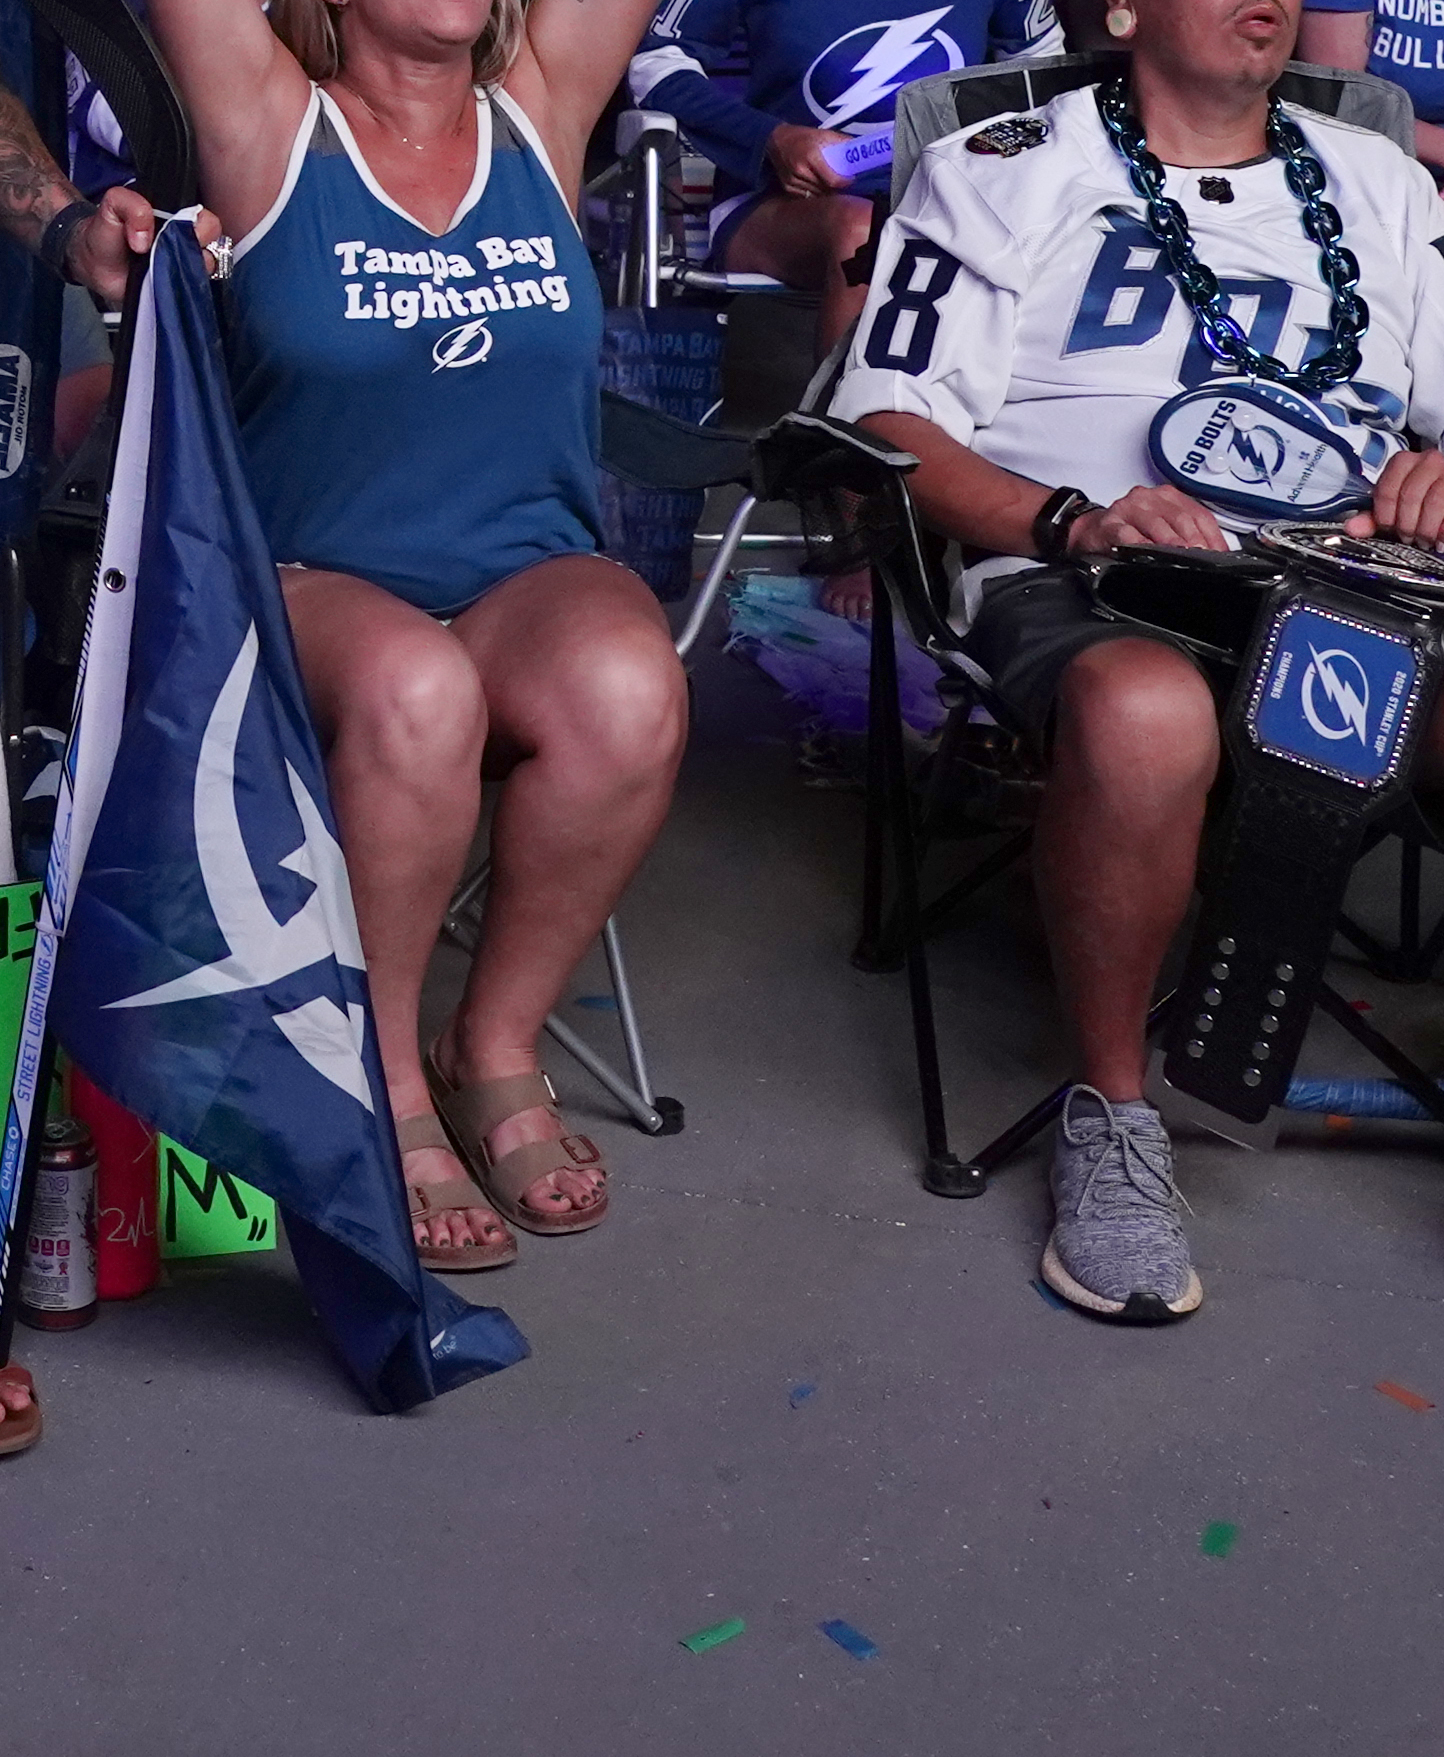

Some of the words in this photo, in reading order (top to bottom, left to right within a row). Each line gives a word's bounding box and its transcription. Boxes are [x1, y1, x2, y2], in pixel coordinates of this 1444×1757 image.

[334, 239, 476, 286] Tampa
[476, 235, 557, 270] Bay
[343, 274, 571, 330] Lightning
[866, 238, 962, 373] 8
[1180, 446, 1207, 475] GO
[1198, 400, 1237, 450] BOLTS
[1270, 651, 1293, 700] CHAMPIONS
[1390, 670, 1408, 693] 2020
[1381, 694, 1400, 733] STANLEY
[26, 957, 55, 1039] LIGHTNING
[17, 1040, 40, 1102] STREET
[0, 1143, 17, 1192] CHASE
